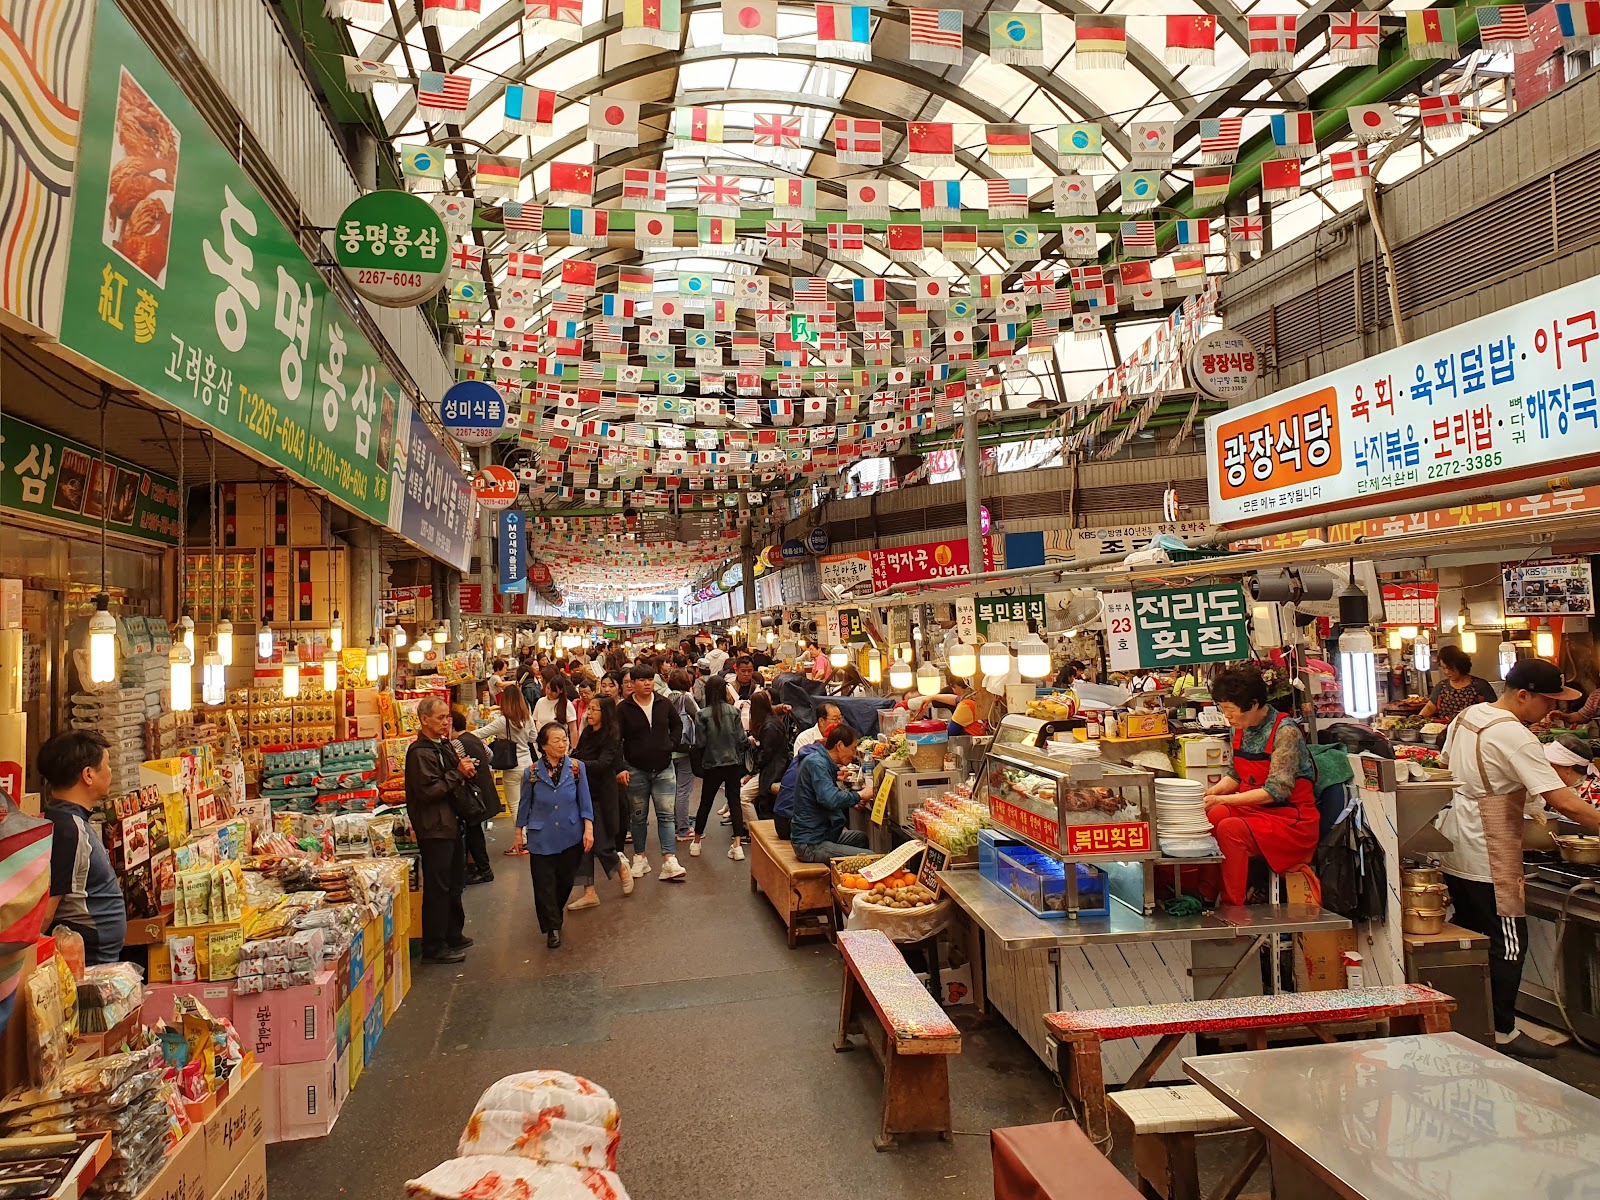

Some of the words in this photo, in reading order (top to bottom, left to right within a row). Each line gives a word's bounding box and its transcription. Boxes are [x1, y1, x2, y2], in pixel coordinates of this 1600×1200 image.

[339, 220, 441, 260] 동명홍삼
[358, 270, 422, 288] 2267-6043
[203, 184, 376, 460] 동명홍삼
[164, 332, 233, 416] 고려홍삼
[1202, 351, 1255, 375] 광장식당
[444, 399, 501, 421] 성미식품
[1526, 379, 1599, 440] 해장국
[455, 428, 493, 438] 2267-2928
[1353, 424, 1420, 477] 낙지볶음
[1433, 403, 1493, 460] 보리밥
[1223, 405, 1334, 488] 광장식당
[1427, 451, 1503, 480] 2272-3385
[424, 451, 458, 530] 성미식품
[475, 478, 516, 493] 대상회
[1078, 531, 1097, 540] KBS
[508, 523, 518, 580] MG새마을금고
[887, 548, 929, 574] 먹자골
[824, 561, 867, 577] 수원아줌마
[1525, 567, 1541, 577] KBS
[961, 615, 973, 625] 25
[1136, 589, 1243, 630] 전라도
[829, 622, 838, 631] 27
[1111, 617, 1132, 634] 23
[1117, 638, 1129, 651] 호
[1151, 625, 1236, 660] 횟집
[1075, 826, 1144, 851] 복민횟집
